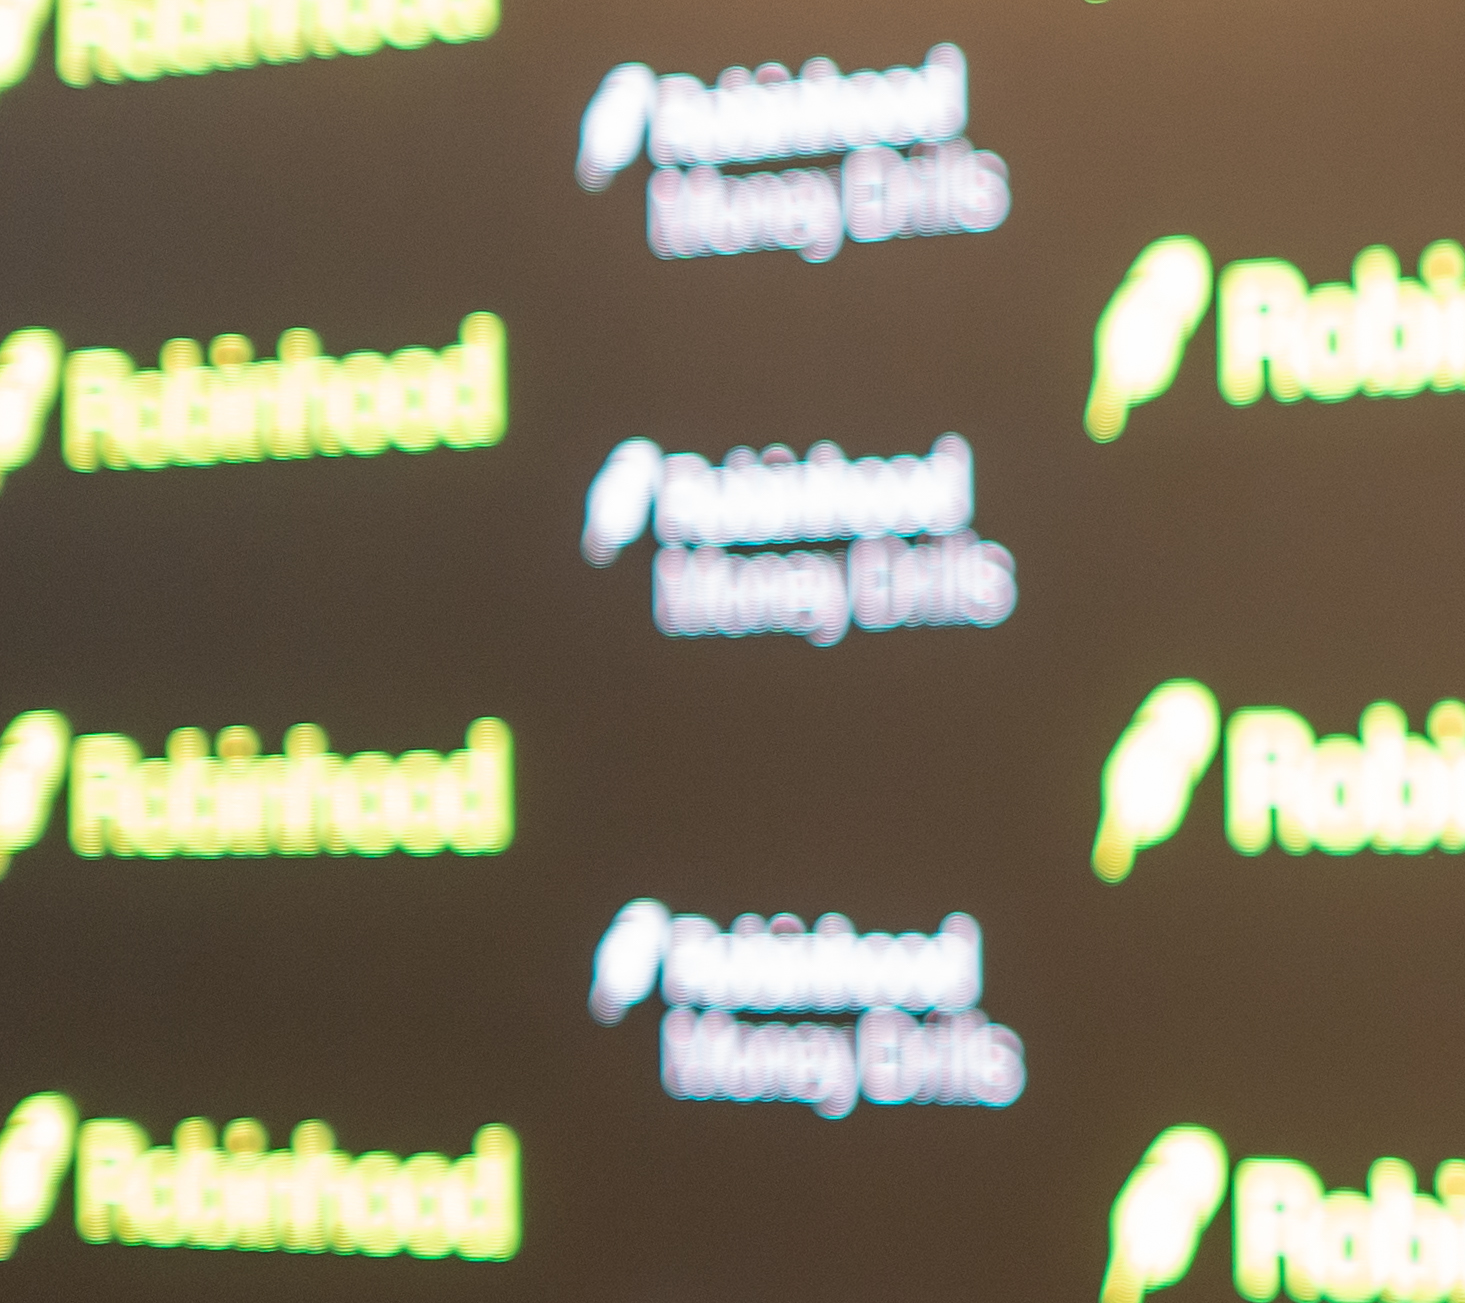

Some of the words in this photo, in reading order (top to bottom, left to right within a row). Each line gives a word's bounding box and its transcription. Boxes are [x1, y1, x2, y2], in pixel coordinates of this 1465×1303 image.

[62, 311, 508, 474] Robinhood
[68, 716, 515, 861] Robinhood
[76, 1117, 522, 1262] Robinhood
